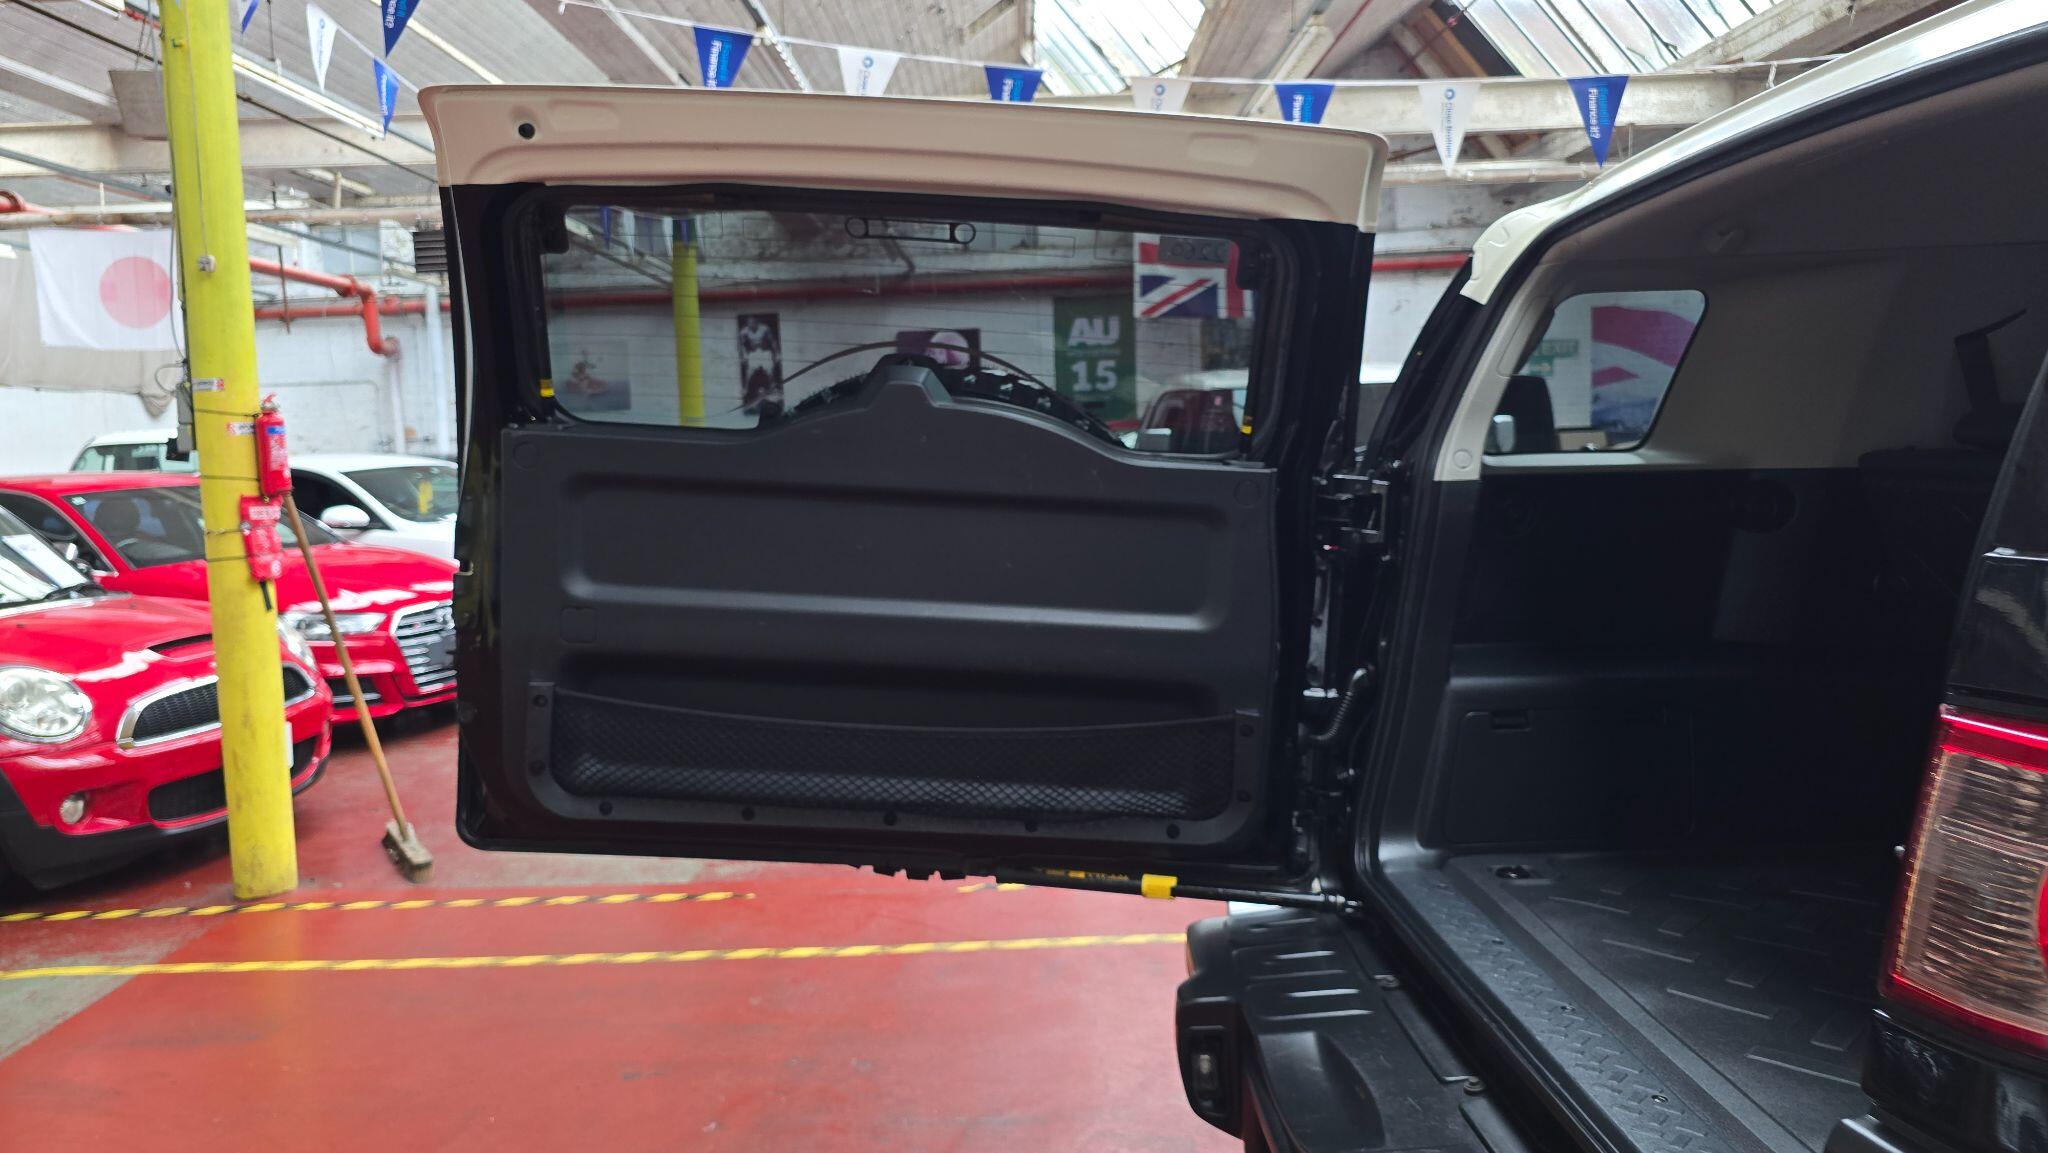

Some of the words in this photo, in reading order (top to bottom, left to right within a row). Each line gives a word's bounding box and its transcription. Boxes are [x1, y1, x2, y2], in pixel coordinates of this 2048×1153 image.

[707, 40, 722, 79] Finance
[1588, 87, 1599, 125] Finance
[1589, 125, 1600, 139] it?
[1067, 317, 1120, 347] AU
[1071, 361, 1117, 391] 15
